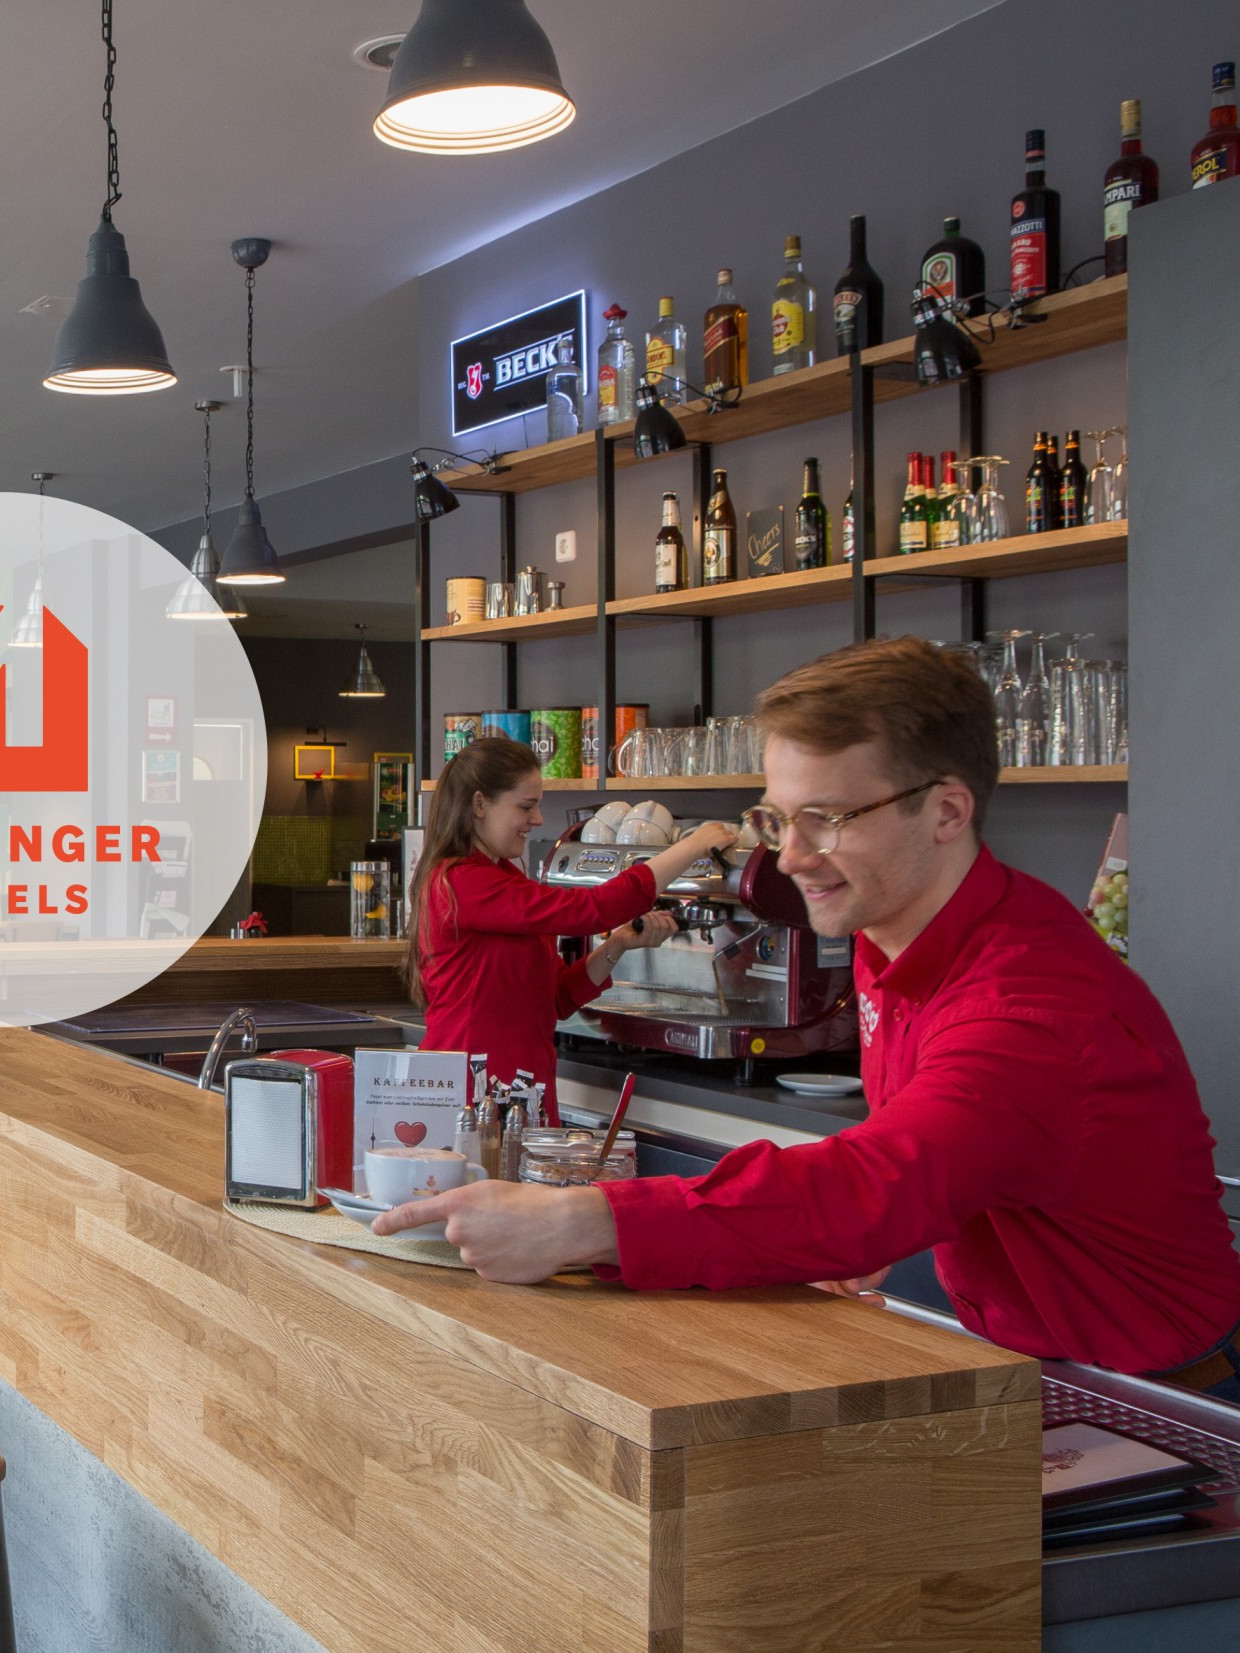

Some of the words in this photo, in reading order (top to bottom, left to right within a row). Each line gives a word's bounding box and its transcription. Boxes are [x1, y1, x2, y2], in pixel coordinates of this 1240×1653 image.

[1192, 158, 1219, 180] EROL
[1105, 184, 1140, 204] MPARI
[748, 523, 780, 560] Cheers
[373, 1077, 454, 1089] KAFFEEBAR
